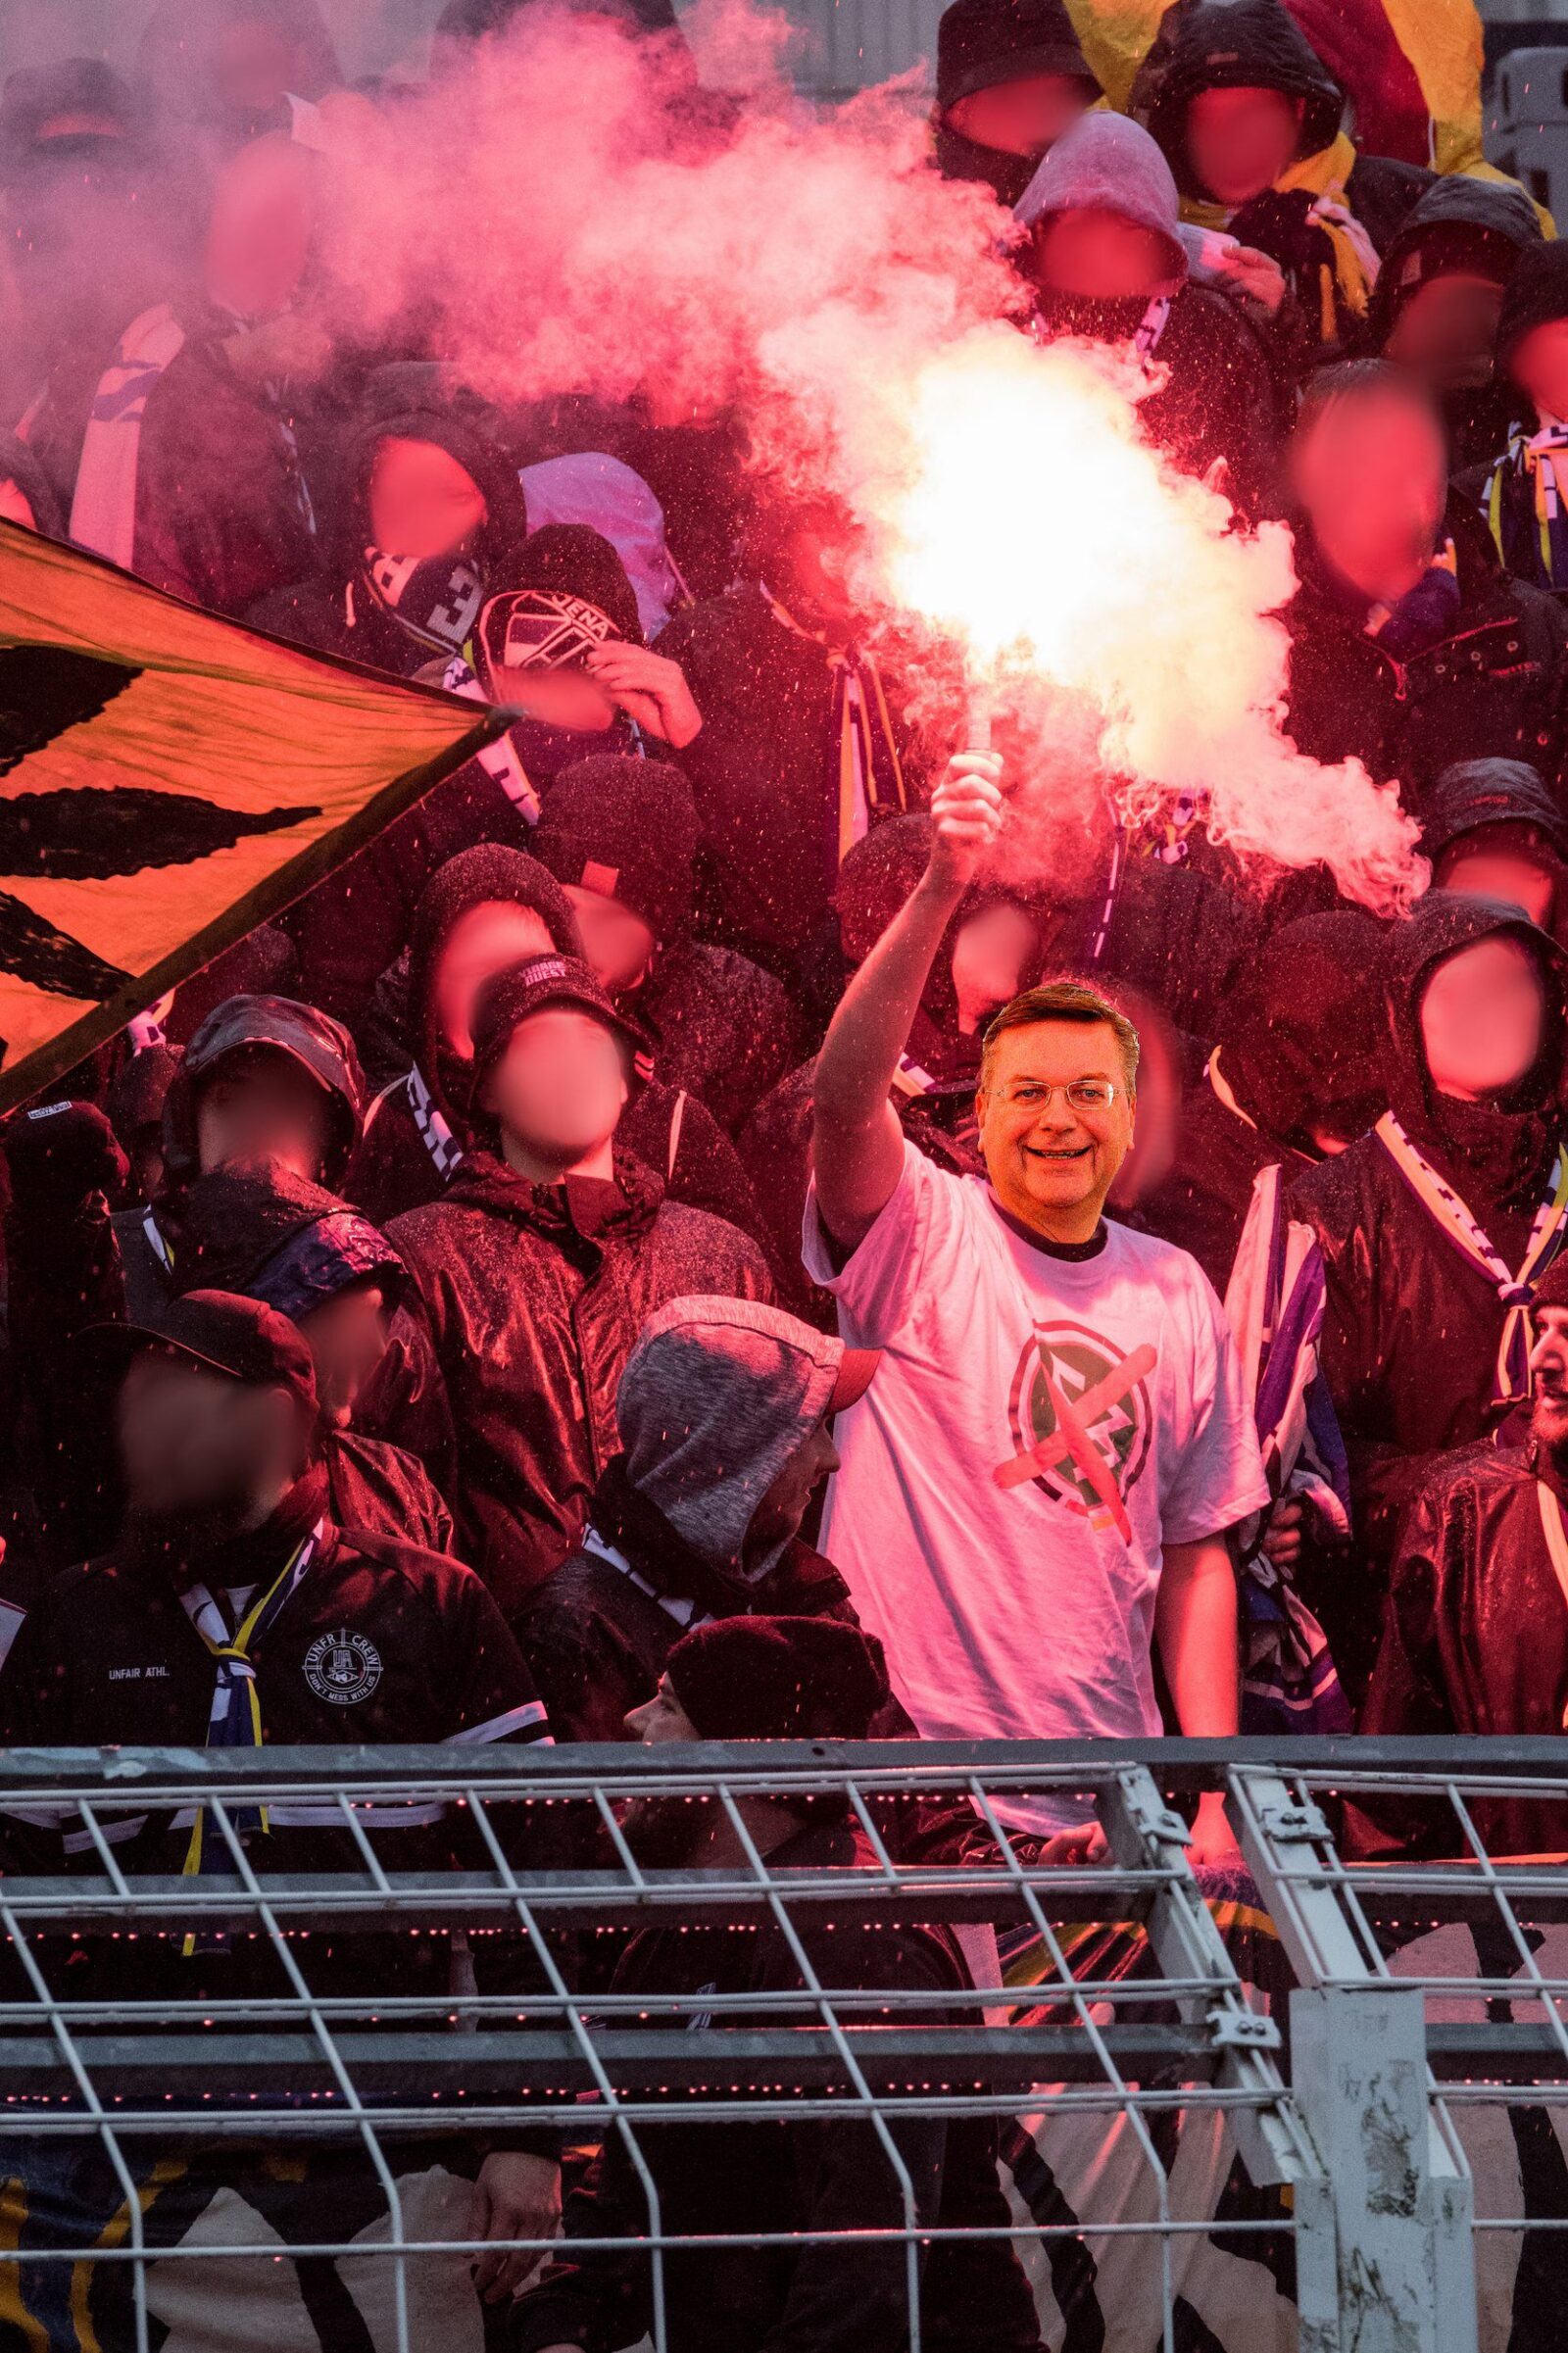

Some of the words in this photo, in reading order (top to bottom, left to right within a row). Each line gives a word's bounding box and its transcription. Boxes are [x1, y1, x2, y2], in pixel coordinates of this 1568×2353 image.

[552, 594, 608, 640] JENA
[307, 1634, 335, 1662] UNFR
[352, 1635, 379, 1665] CREW
[109, 1668, 141, 1680] UNFAIR
[309, 1673, 327, 1694] DON'T
[328, 1692, 349, 1701] MESS
[350, 1686, 368, 1700] WITH
[366, 1675, 376, 1687] US
